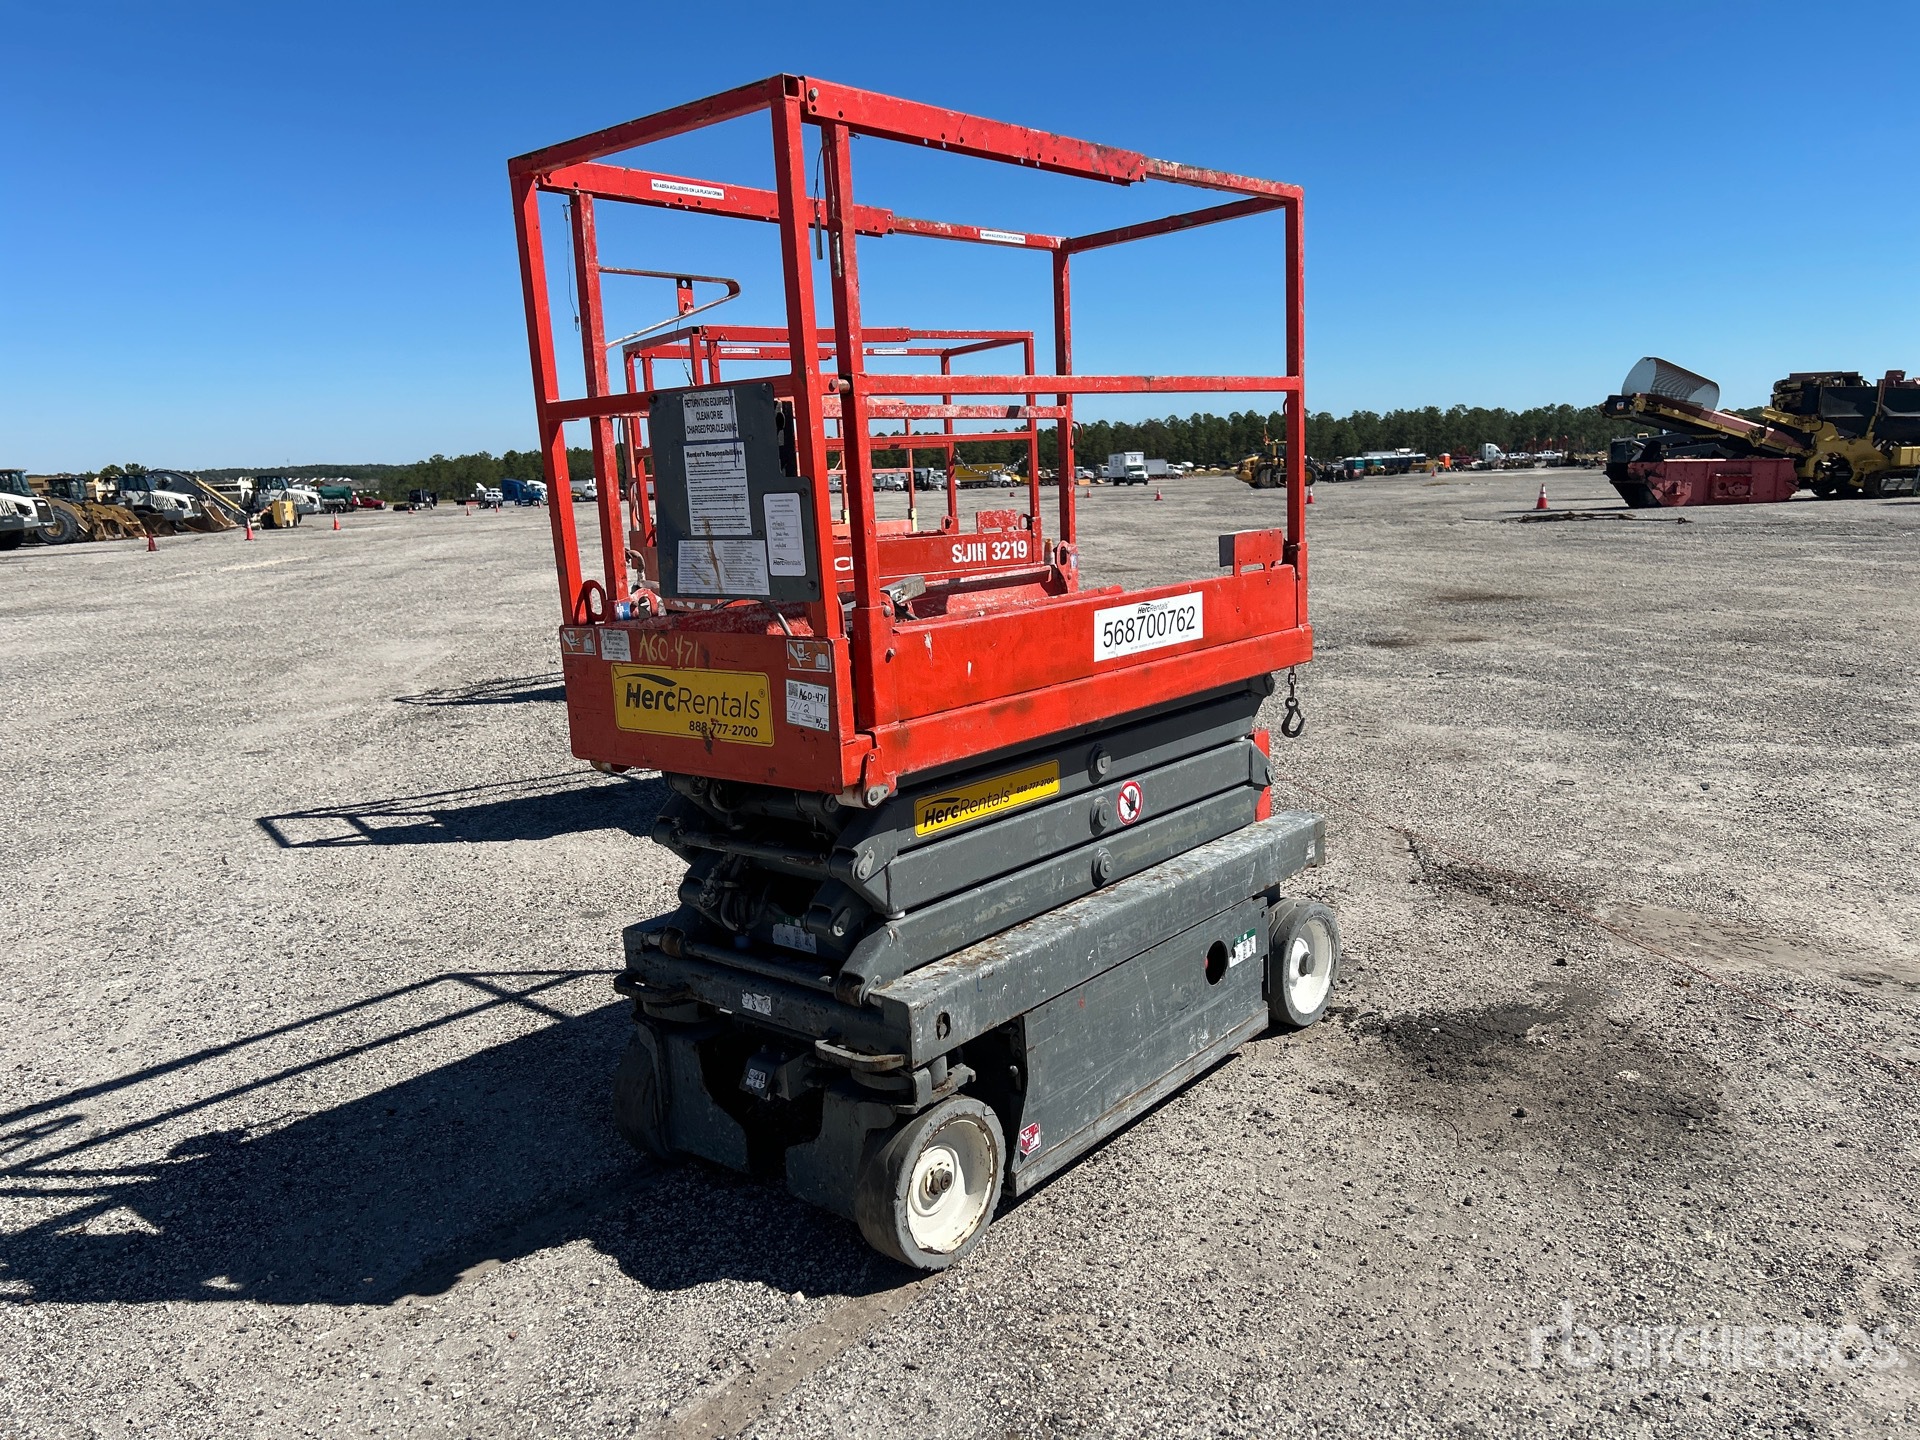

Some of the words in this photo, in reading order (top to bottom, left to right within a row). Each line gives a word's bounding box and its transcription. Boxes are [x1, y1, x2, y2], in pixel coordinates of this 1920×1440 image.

[696, 411, 710, 421] CLEAN
[717, 410, 724, 420] BE
[991, 540, 1028, 561] 3219
[1103, 605, 1196, 648] 568700762
[688, 720, 759, 739] 888-777-2700
[1016, 776, 1056, 794] 888-777-2700
